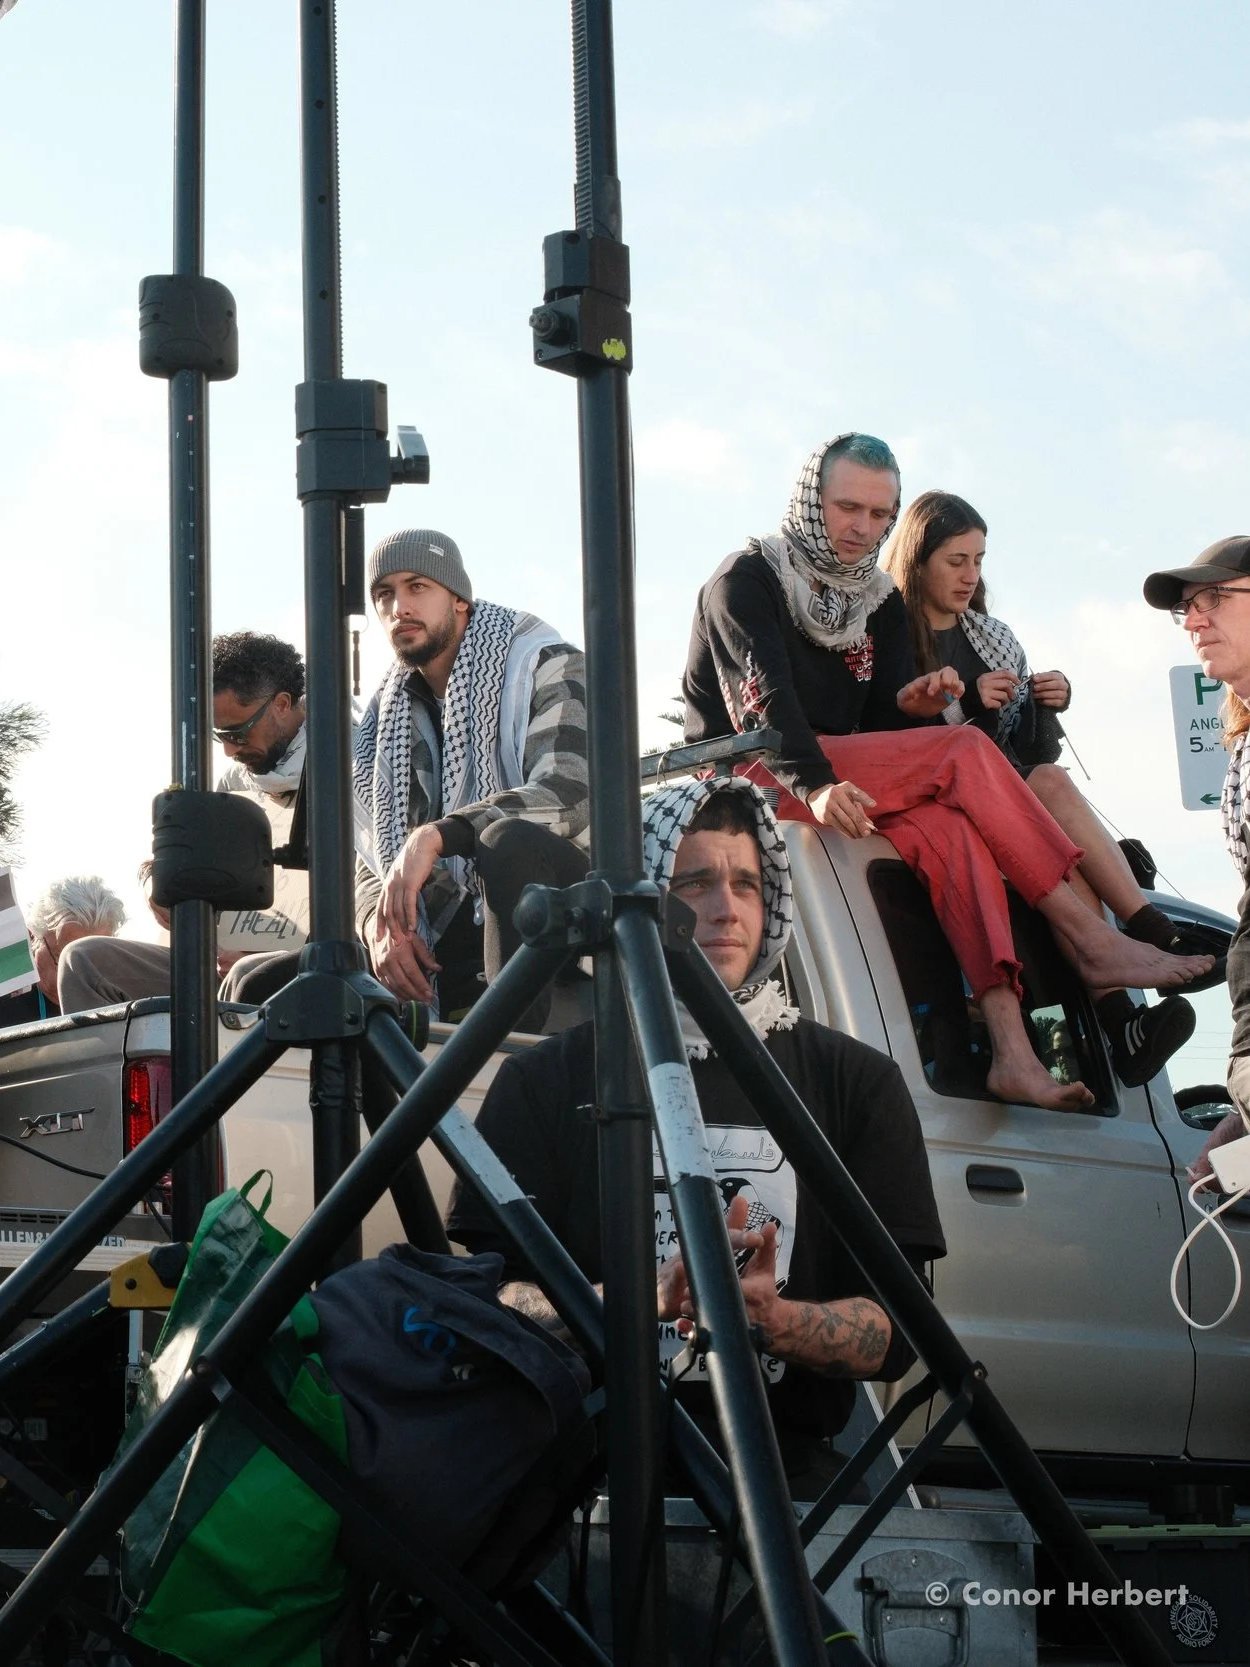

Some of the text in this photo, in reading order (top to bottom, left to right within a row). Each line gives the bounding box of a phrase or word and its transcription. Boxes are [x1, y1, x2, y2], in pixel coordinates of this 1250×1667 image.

[1190, 717, 1225, 731] ANG
[19, 1106, 95, 1139] XLT
[1187, 1593, 1219, 1629] SOLIDARITY
[1175, 1630, 1217, 1649] AUDIO FORCE
